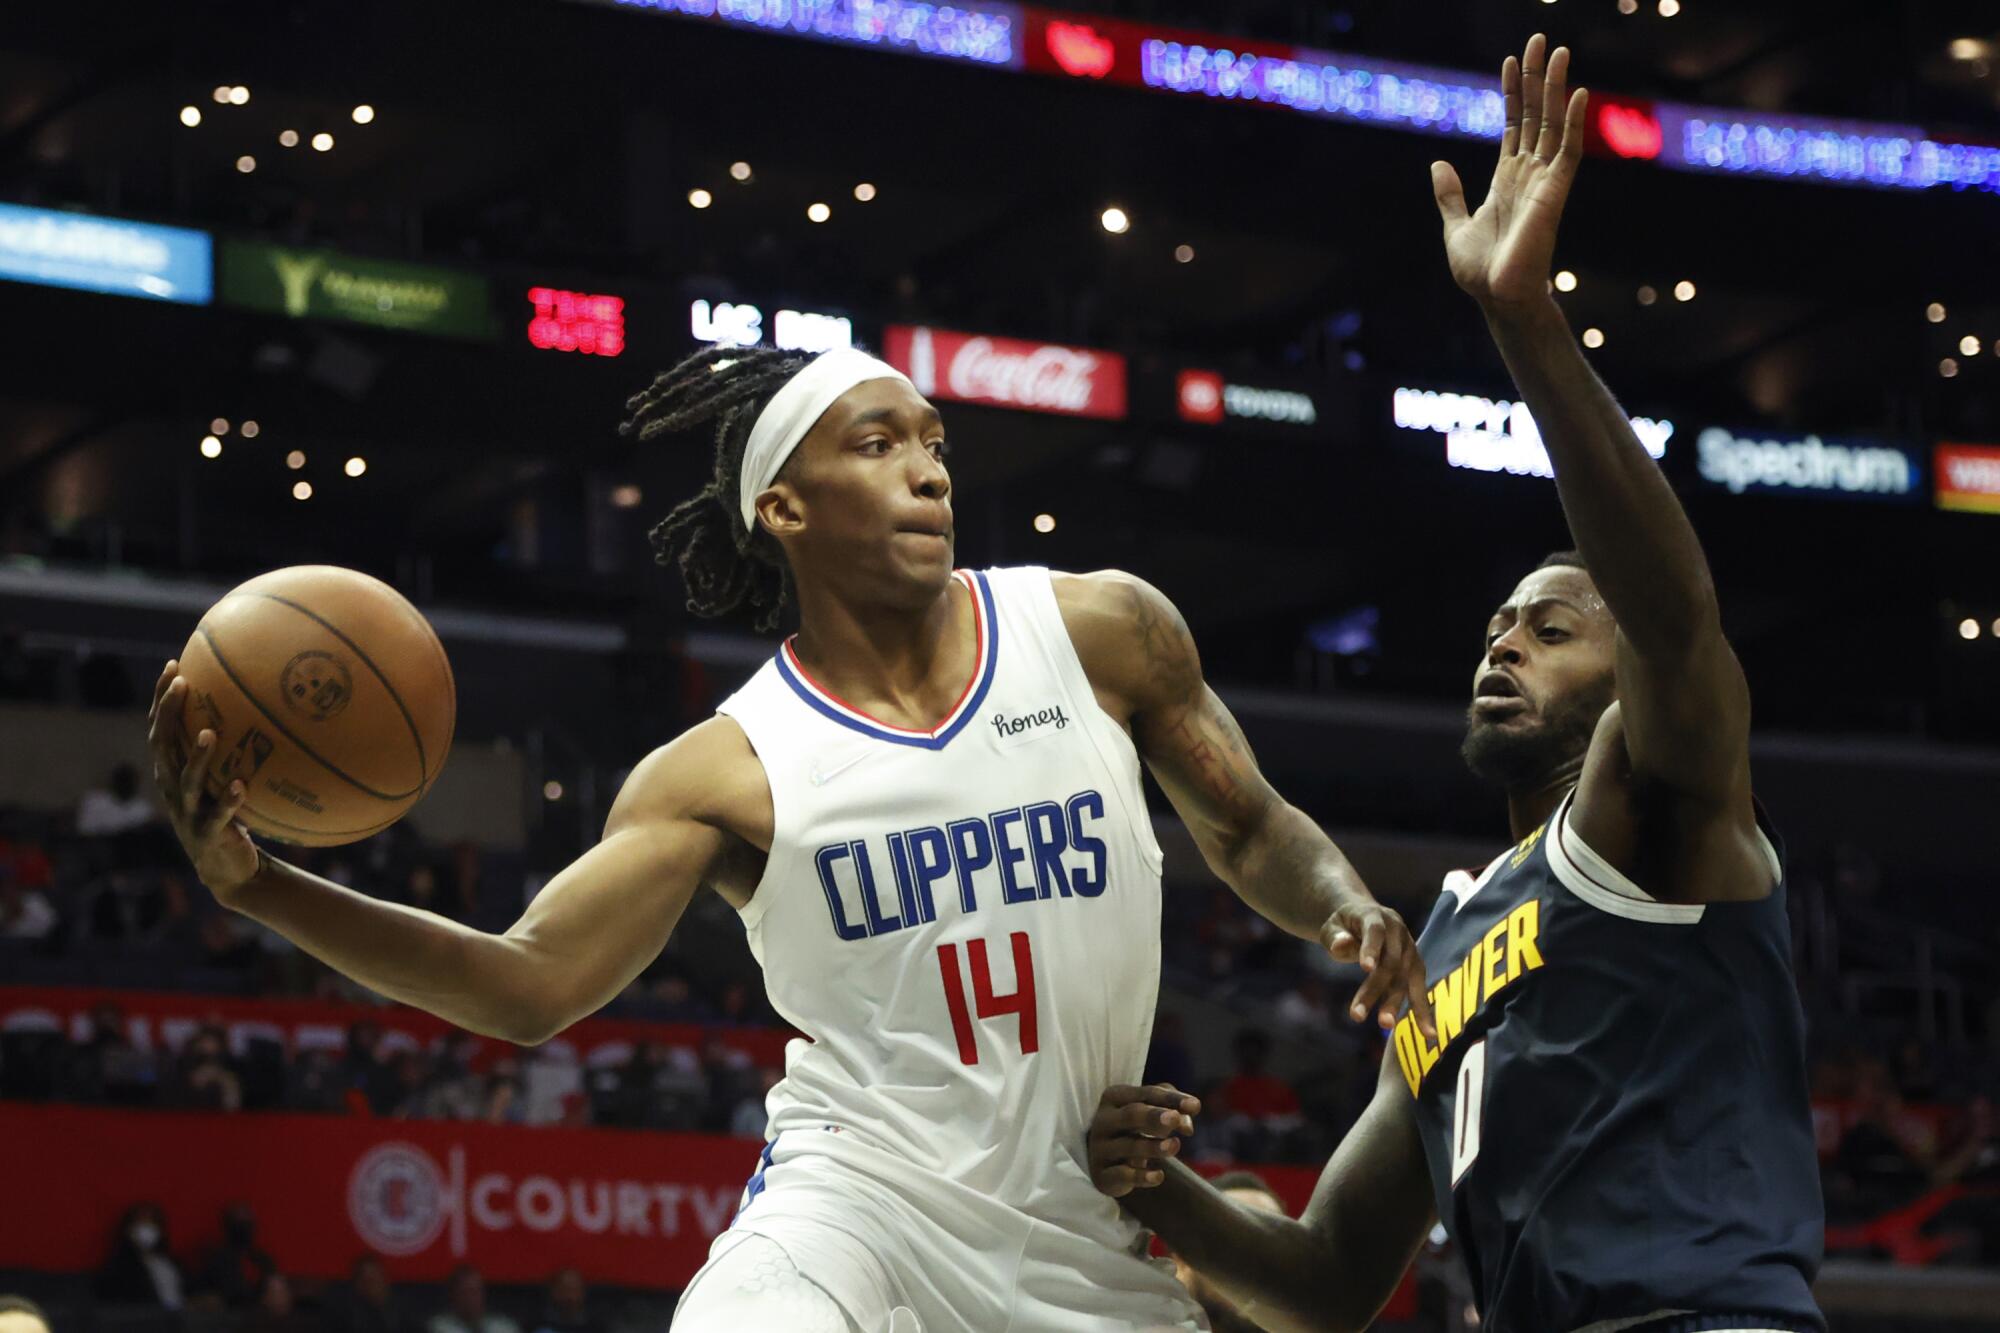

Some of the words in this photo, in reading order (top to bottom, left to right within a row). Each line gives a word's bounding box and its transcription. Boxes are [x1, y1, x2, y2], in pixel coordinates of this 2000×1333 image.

[1697, 427, 1909, 494] Spectrum
[991, 704, 1070, 738] honey
[814, 789, 1107, 941] CLIPPERS
[936, 931, 1039, 1066] 14
[1451, 1038, 1487, 1192] 0
